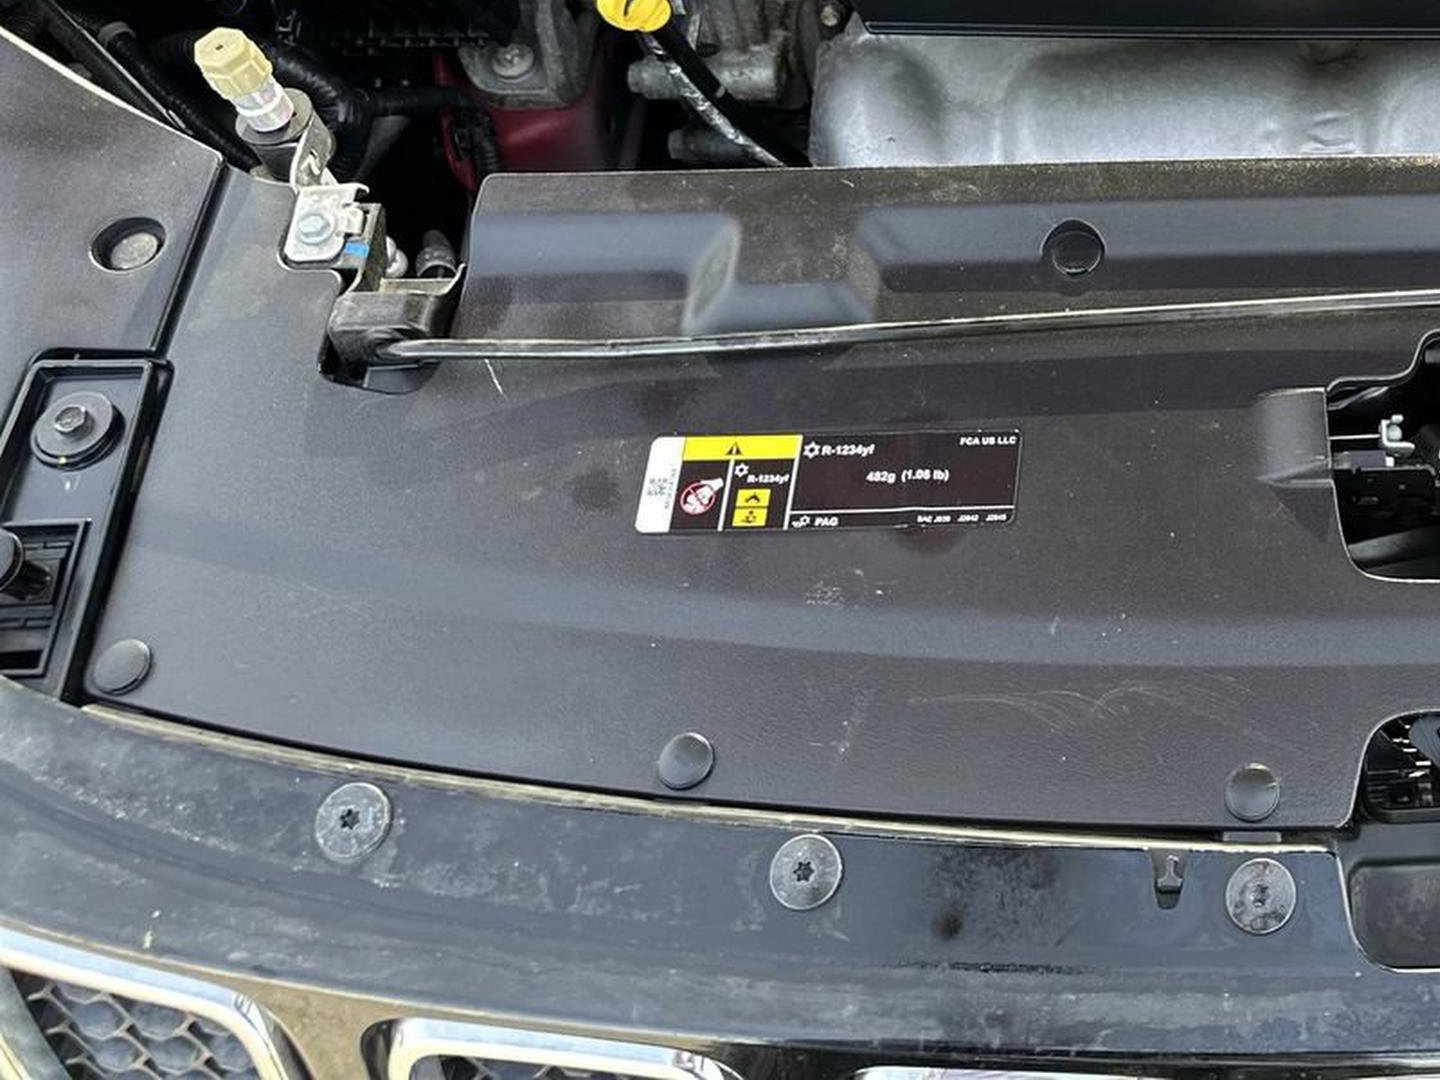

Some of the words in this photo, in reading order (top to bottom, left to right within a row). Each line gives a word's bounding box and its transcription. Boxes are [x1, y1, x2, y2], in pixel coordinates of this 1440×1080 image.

[959, 436, 979, 446] FCA
[981, 436, 996, 445] US
[997, 435, 1017, 445] LLC
[821, 443, 876, 458] R-1234yf
[746, 473, 790, 485] R-1234yf
[866, 470, 896, 484] 482g
[933, 468, 950, 481] lb)
[814, 517, 839, 527] PAG
